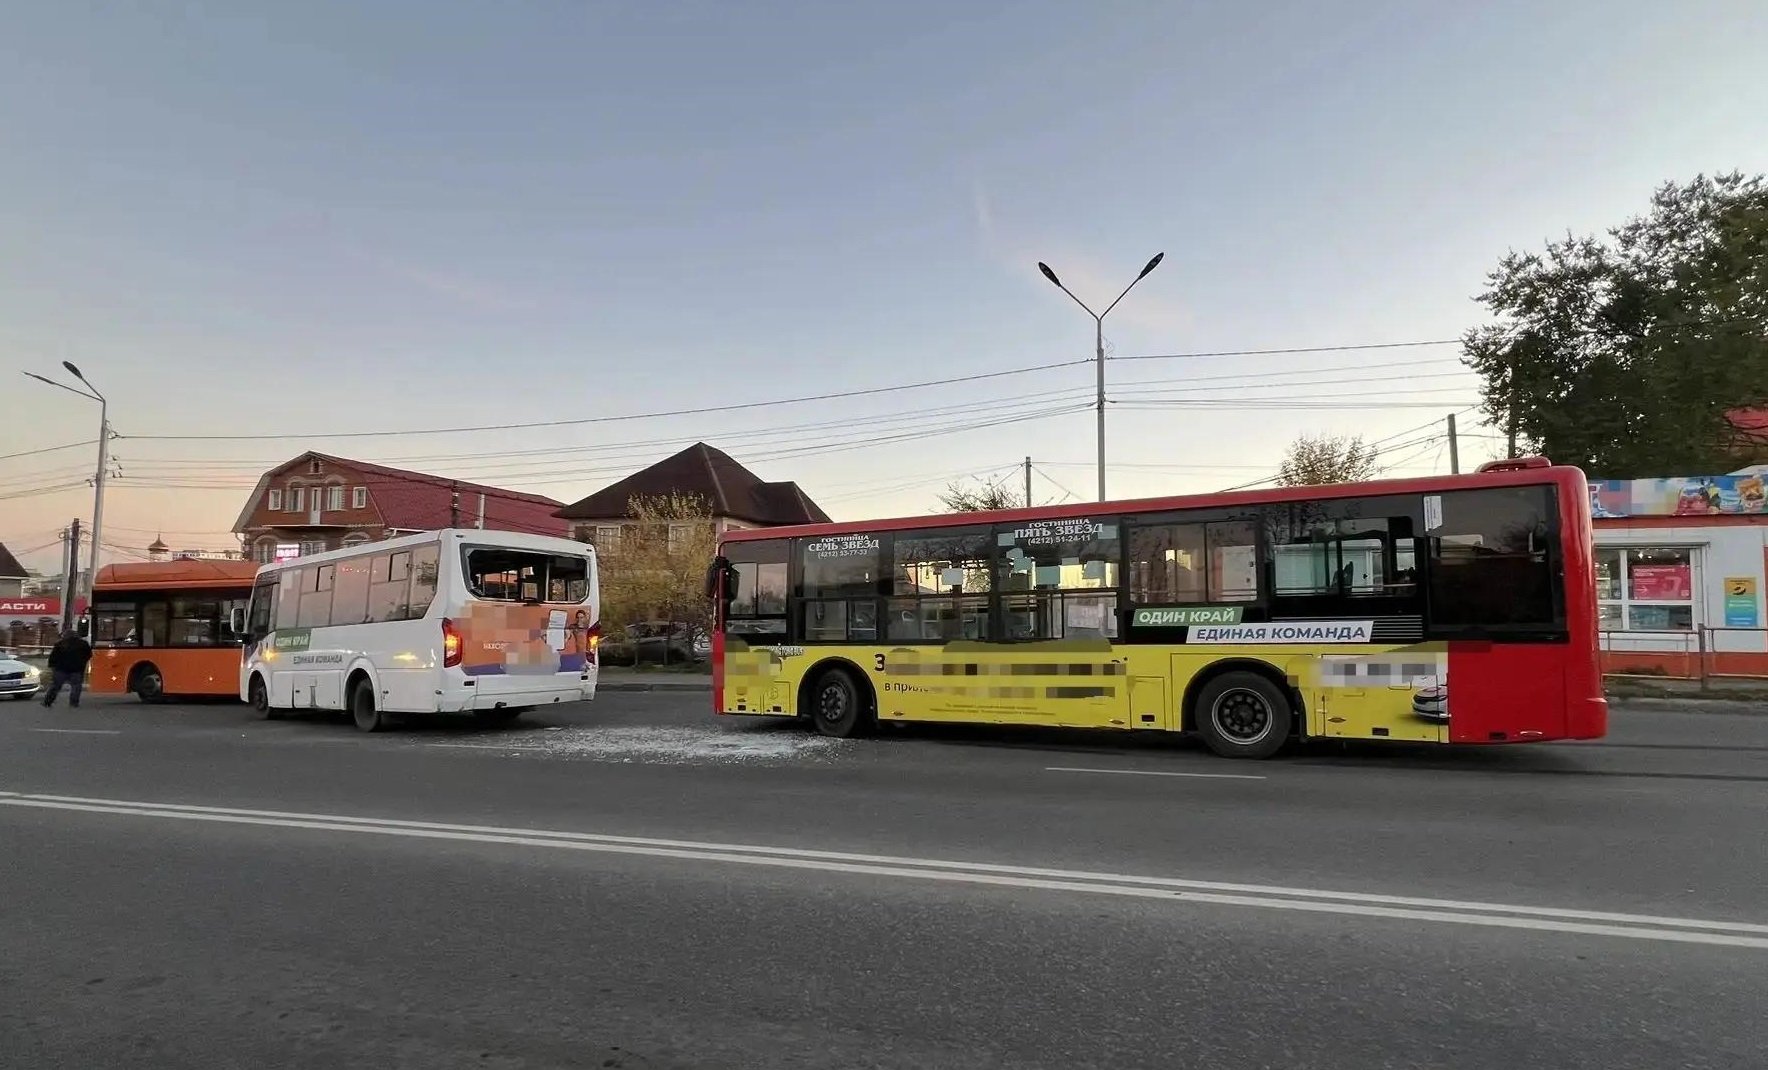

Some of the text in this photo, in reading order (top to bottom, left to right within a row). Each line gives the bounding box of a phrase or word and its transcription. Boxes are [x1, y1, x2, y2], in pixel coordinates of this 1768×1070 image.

[1029, 518, 1090, 528] ГОСТИНИЦА
[1014, 523, 1103, 538] ПЯТЬ ЗВЕЗД
[808, 540, 880, 552] СЕМЬ ЗВЕЗД
[1028, 534, 1090, 545] (4212) 51-24-11
[1139, 607, 1235, 623] ОДИН КРАЙ
[1196, 626, 1365, 640] ЕДИНАЯ КОМАНДА
